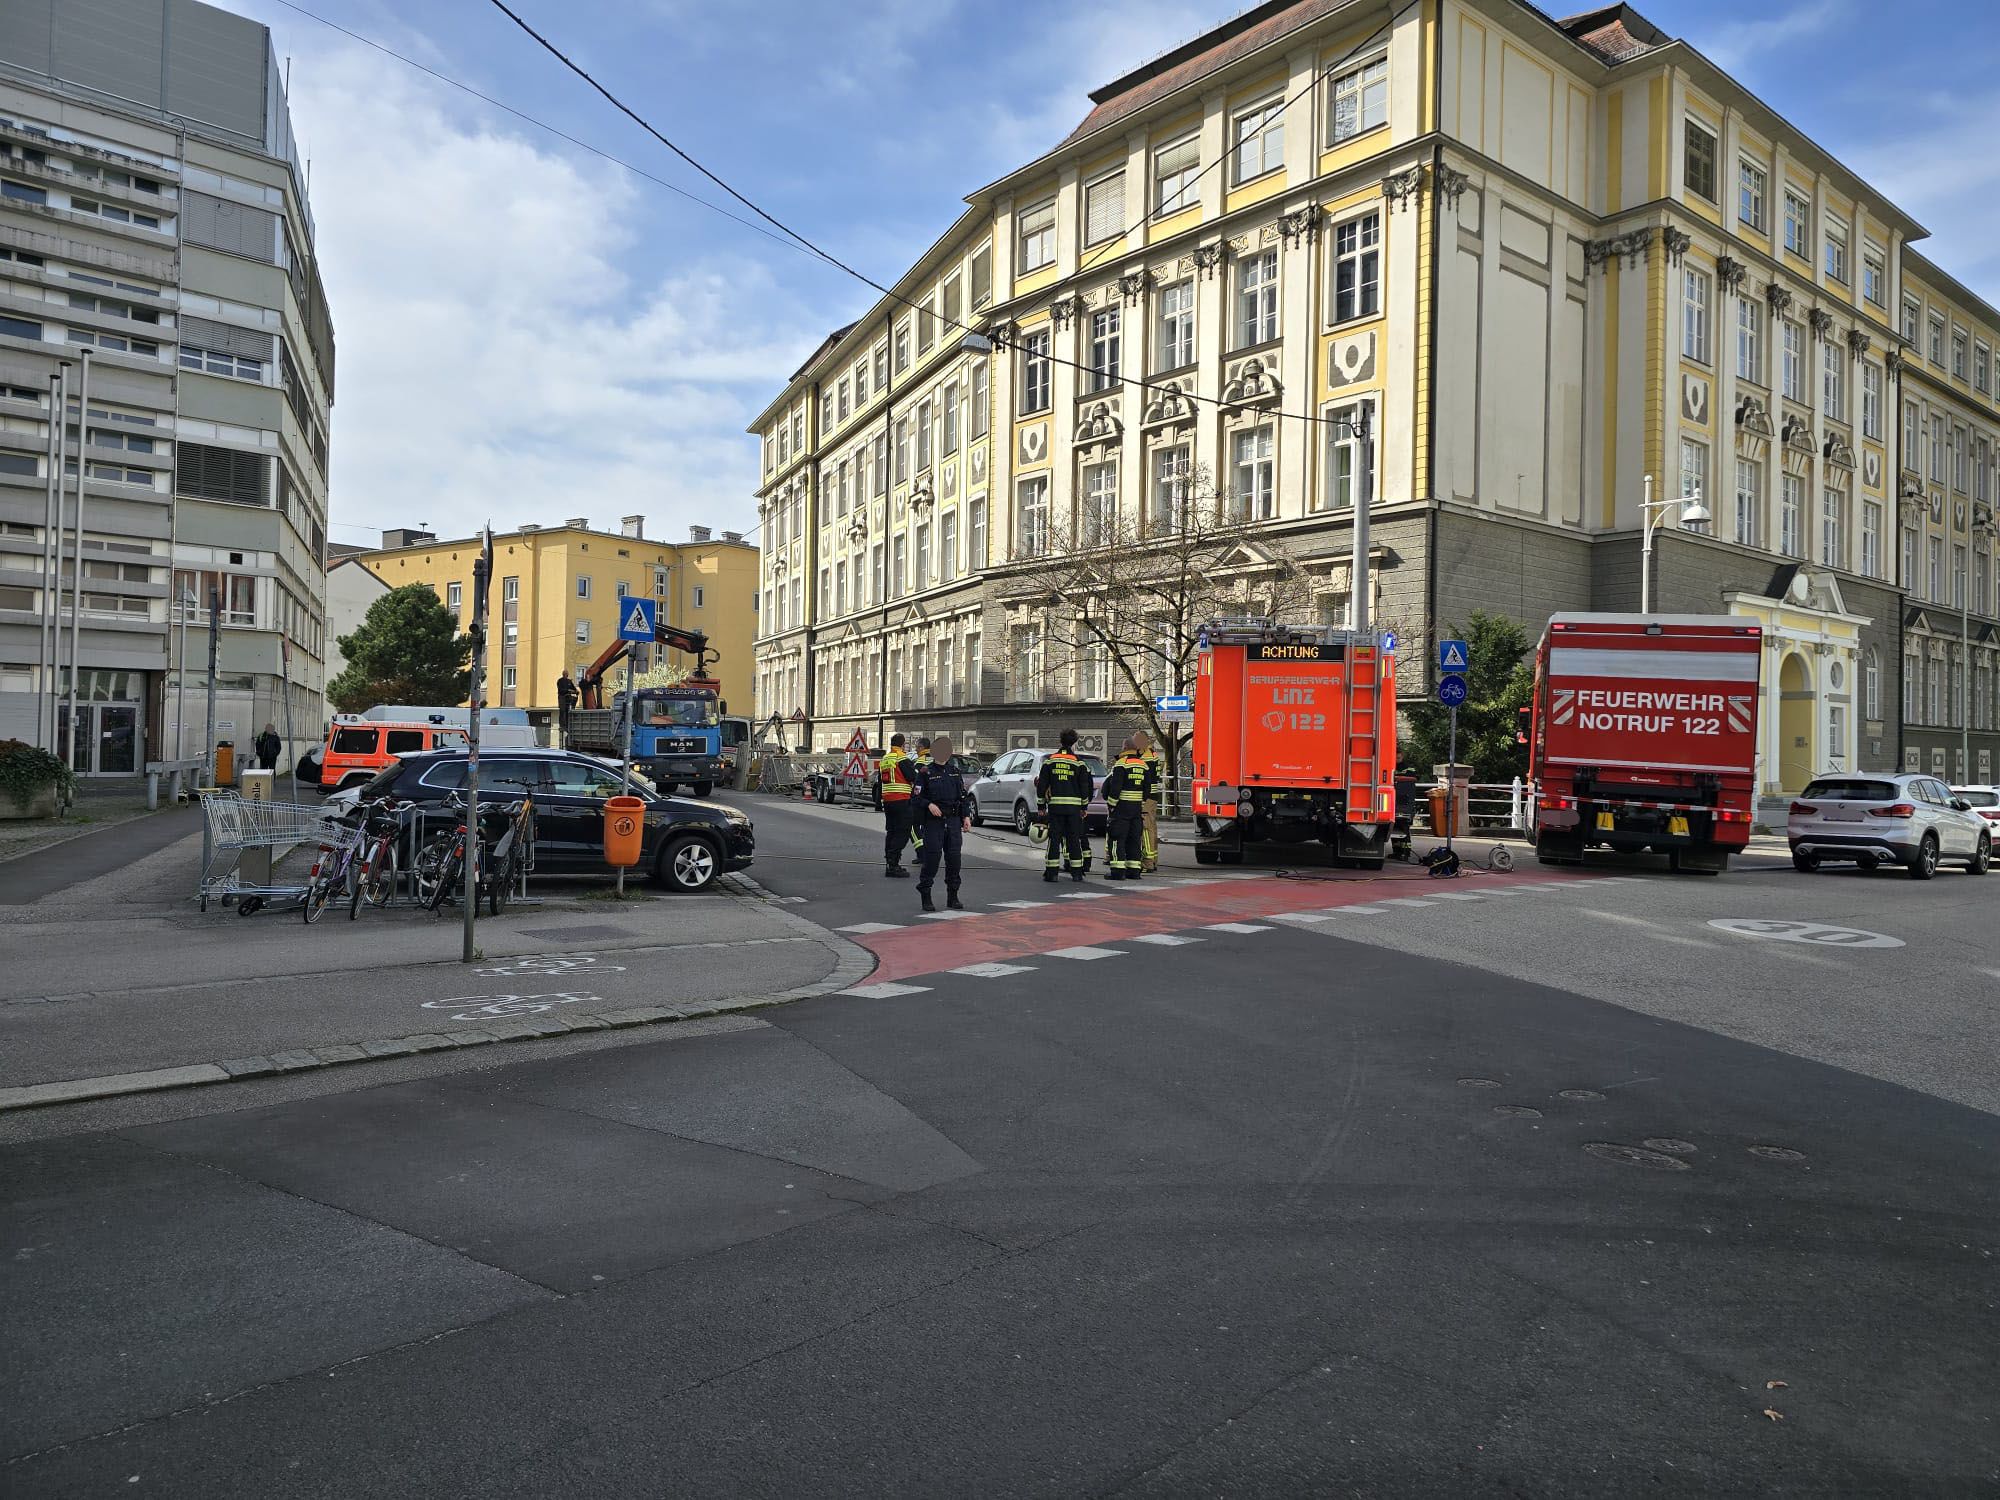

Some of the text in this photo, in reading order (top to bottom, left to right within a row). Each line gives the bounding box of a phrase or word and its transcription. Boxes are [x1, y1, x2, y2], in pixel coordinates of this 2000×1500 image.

[1261, 645, 1319, 658] ACHTUNG
[1577, 690, 1725, 712] FEUERWEHR
[1289, 713, 1326, 730] 122
[1579, 713, 1721, 735] NOTRUF 122
